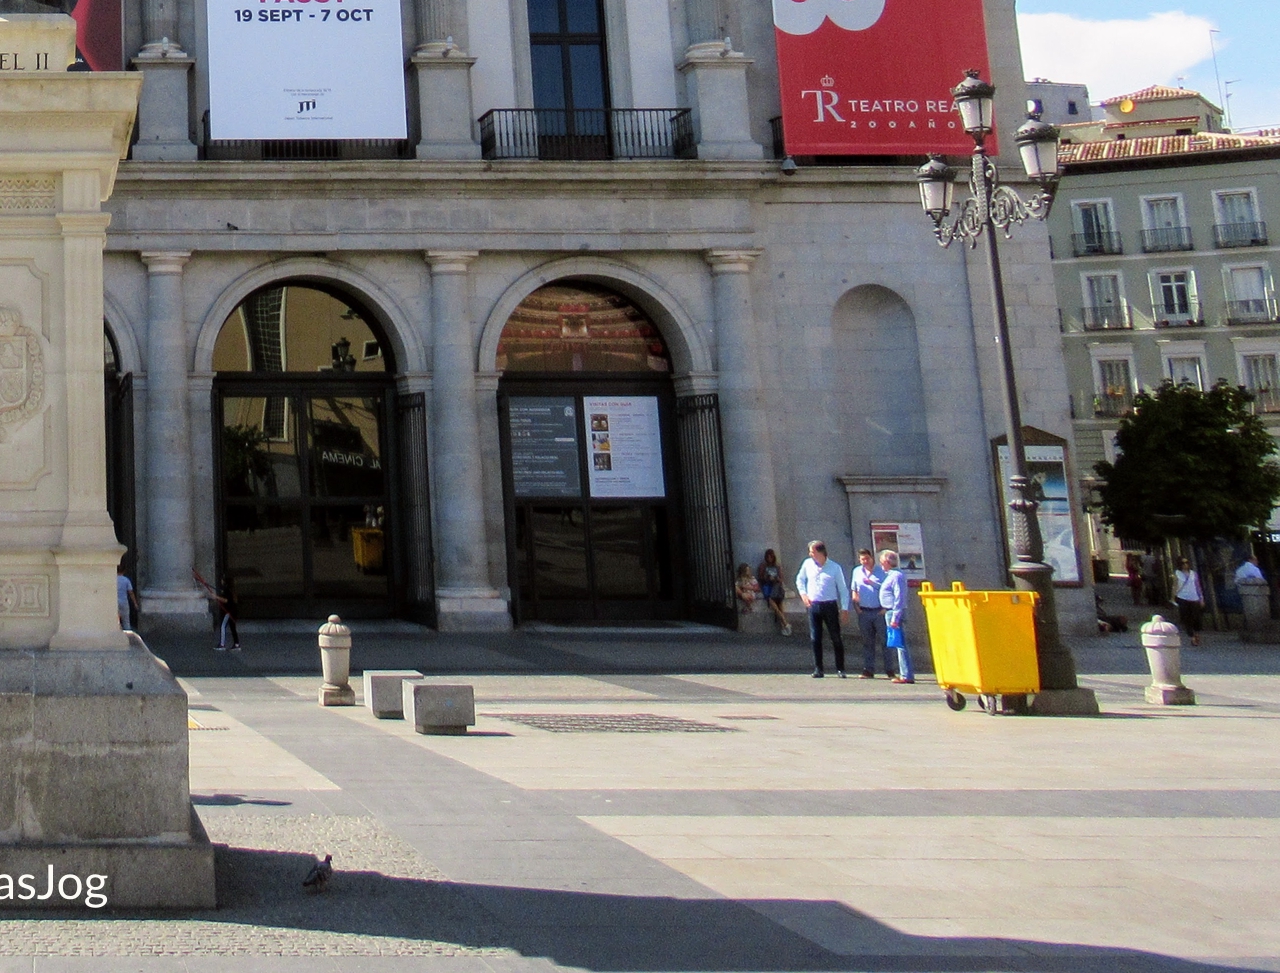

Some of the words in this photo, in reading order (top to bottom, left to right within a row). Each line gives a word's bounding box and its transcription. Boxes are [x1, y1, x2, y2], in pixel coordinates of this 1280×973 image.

[234, 8, 253, 22] 19
[258, 8, 304, 22] SEPT
[320, 9, 331, 22] 7
[336, 8, 374, 22] OCT
[36, 52, 49, 70] II
[848, 100, 919, 113] TEATRO
